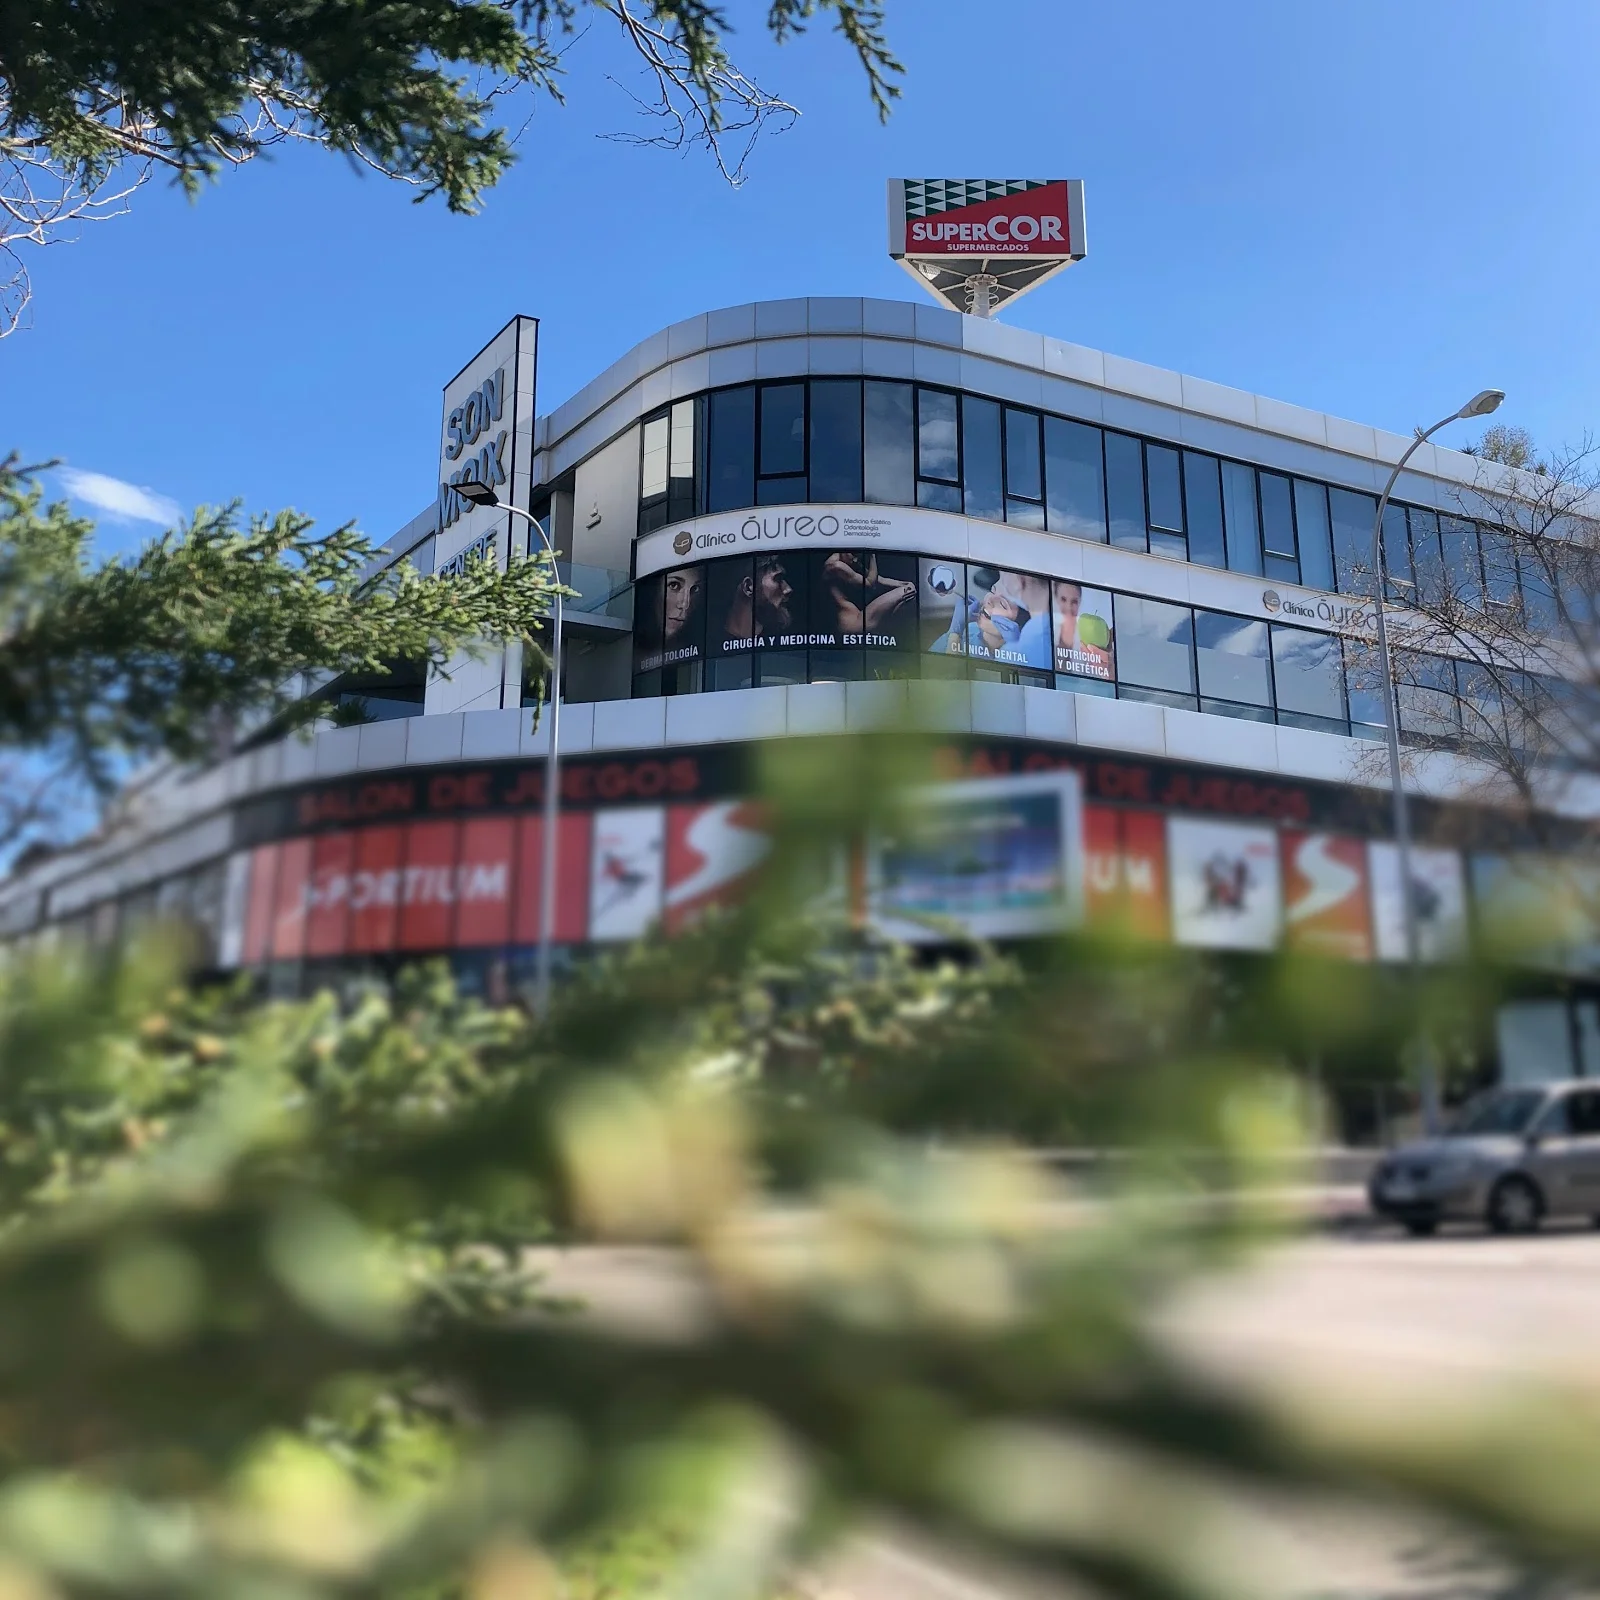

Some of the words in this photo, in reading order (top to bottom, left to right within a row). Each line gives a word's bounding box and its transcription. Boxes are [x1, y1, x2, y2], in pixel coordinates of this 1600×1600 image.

[912, 215, 1065, 241] SUPERCOR
[446, 368, 504, 460] SON
[435, 430, 507, 534] MOIX
[695, 532, 736, 548] Clínica
[1282, 601, 1315, 618] Clínica
[723, 637, 765, 650] CIRUGÍA
[769, 636, 776, 646] Y
[780, 634, 836, 646] MEDICINA
[843, 633, 897, 646] ESTÉTICA
[951, 642, 990, 657] CLÍNICA
[994, 649, 1028, 663] DENTAL
[1057, 647, 1101, 662] NUTRICIÓN
[1058, 659, 1063, 669] Y
[1066, 661, 1110, 677] DIETÉTICA
[429, 772, 490, 807] DE
